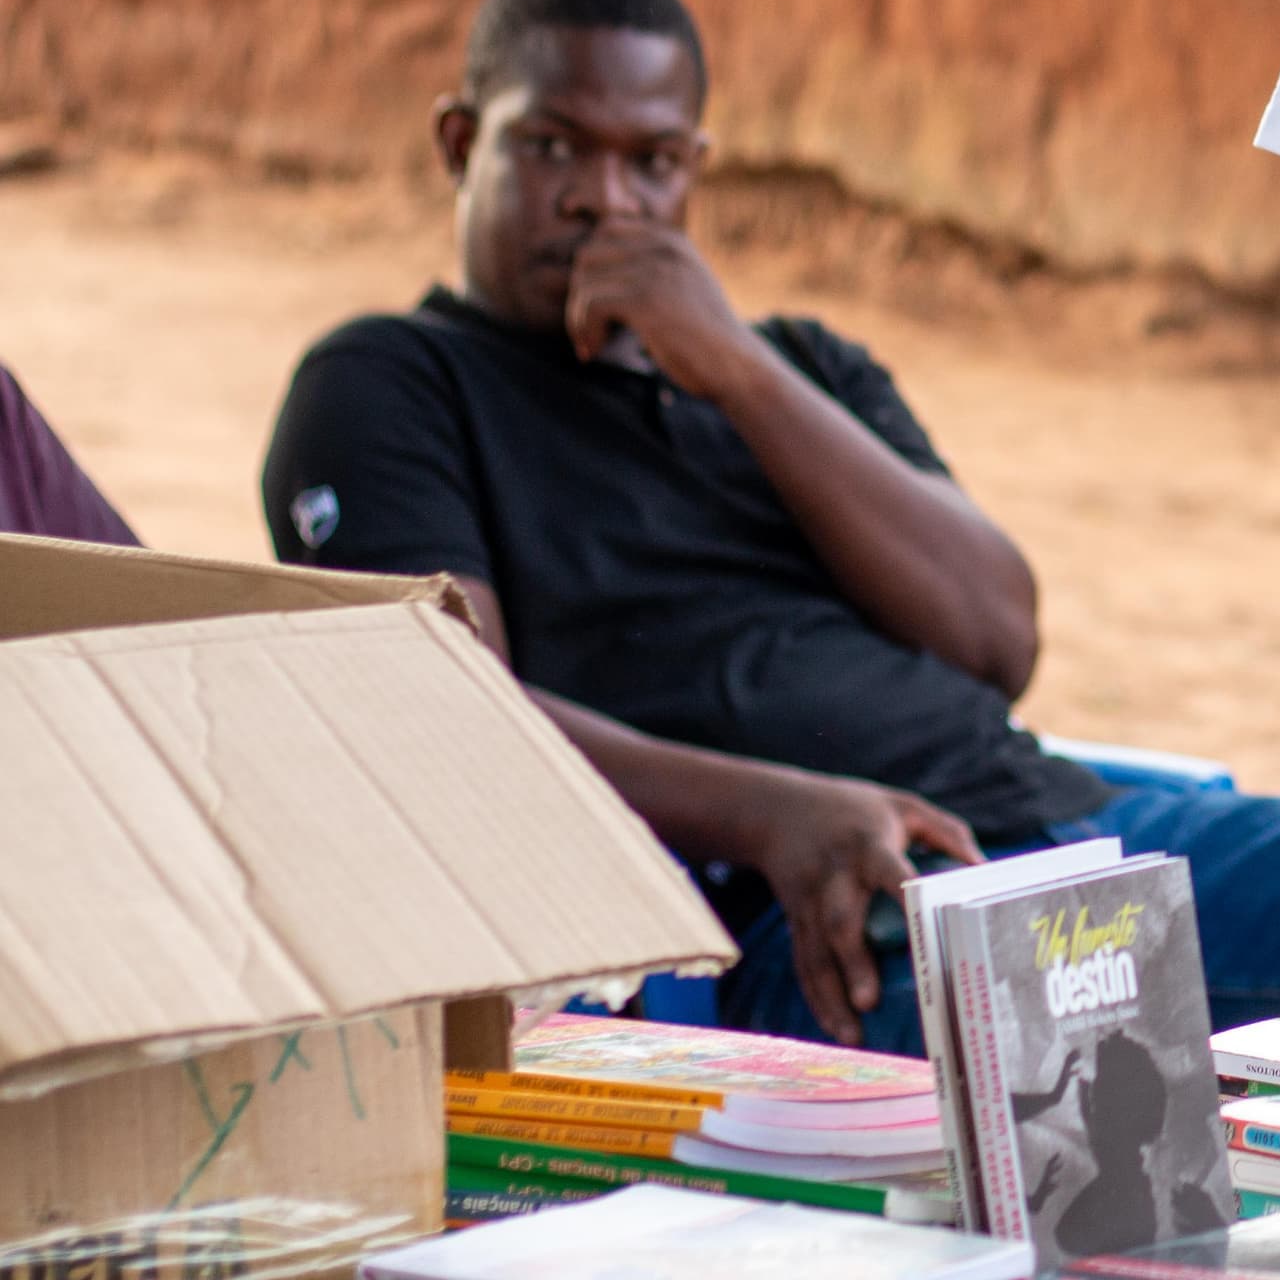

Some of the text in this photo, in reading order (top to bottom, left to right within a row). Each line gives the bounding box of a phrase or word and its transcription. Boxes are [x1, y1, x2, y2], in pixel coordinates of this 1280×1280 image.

[958, 959, 975, 1021] destin
[1046, 940, 1138, 1019] destin
[974, 963, 992, 1025] destin
[1251, 1130, 1276, 1147] SOIF
[497, 1153, 534, 1171] CP1
[548, 1159, 616, 1183] français
[620, 1168, 643, 1184] de
